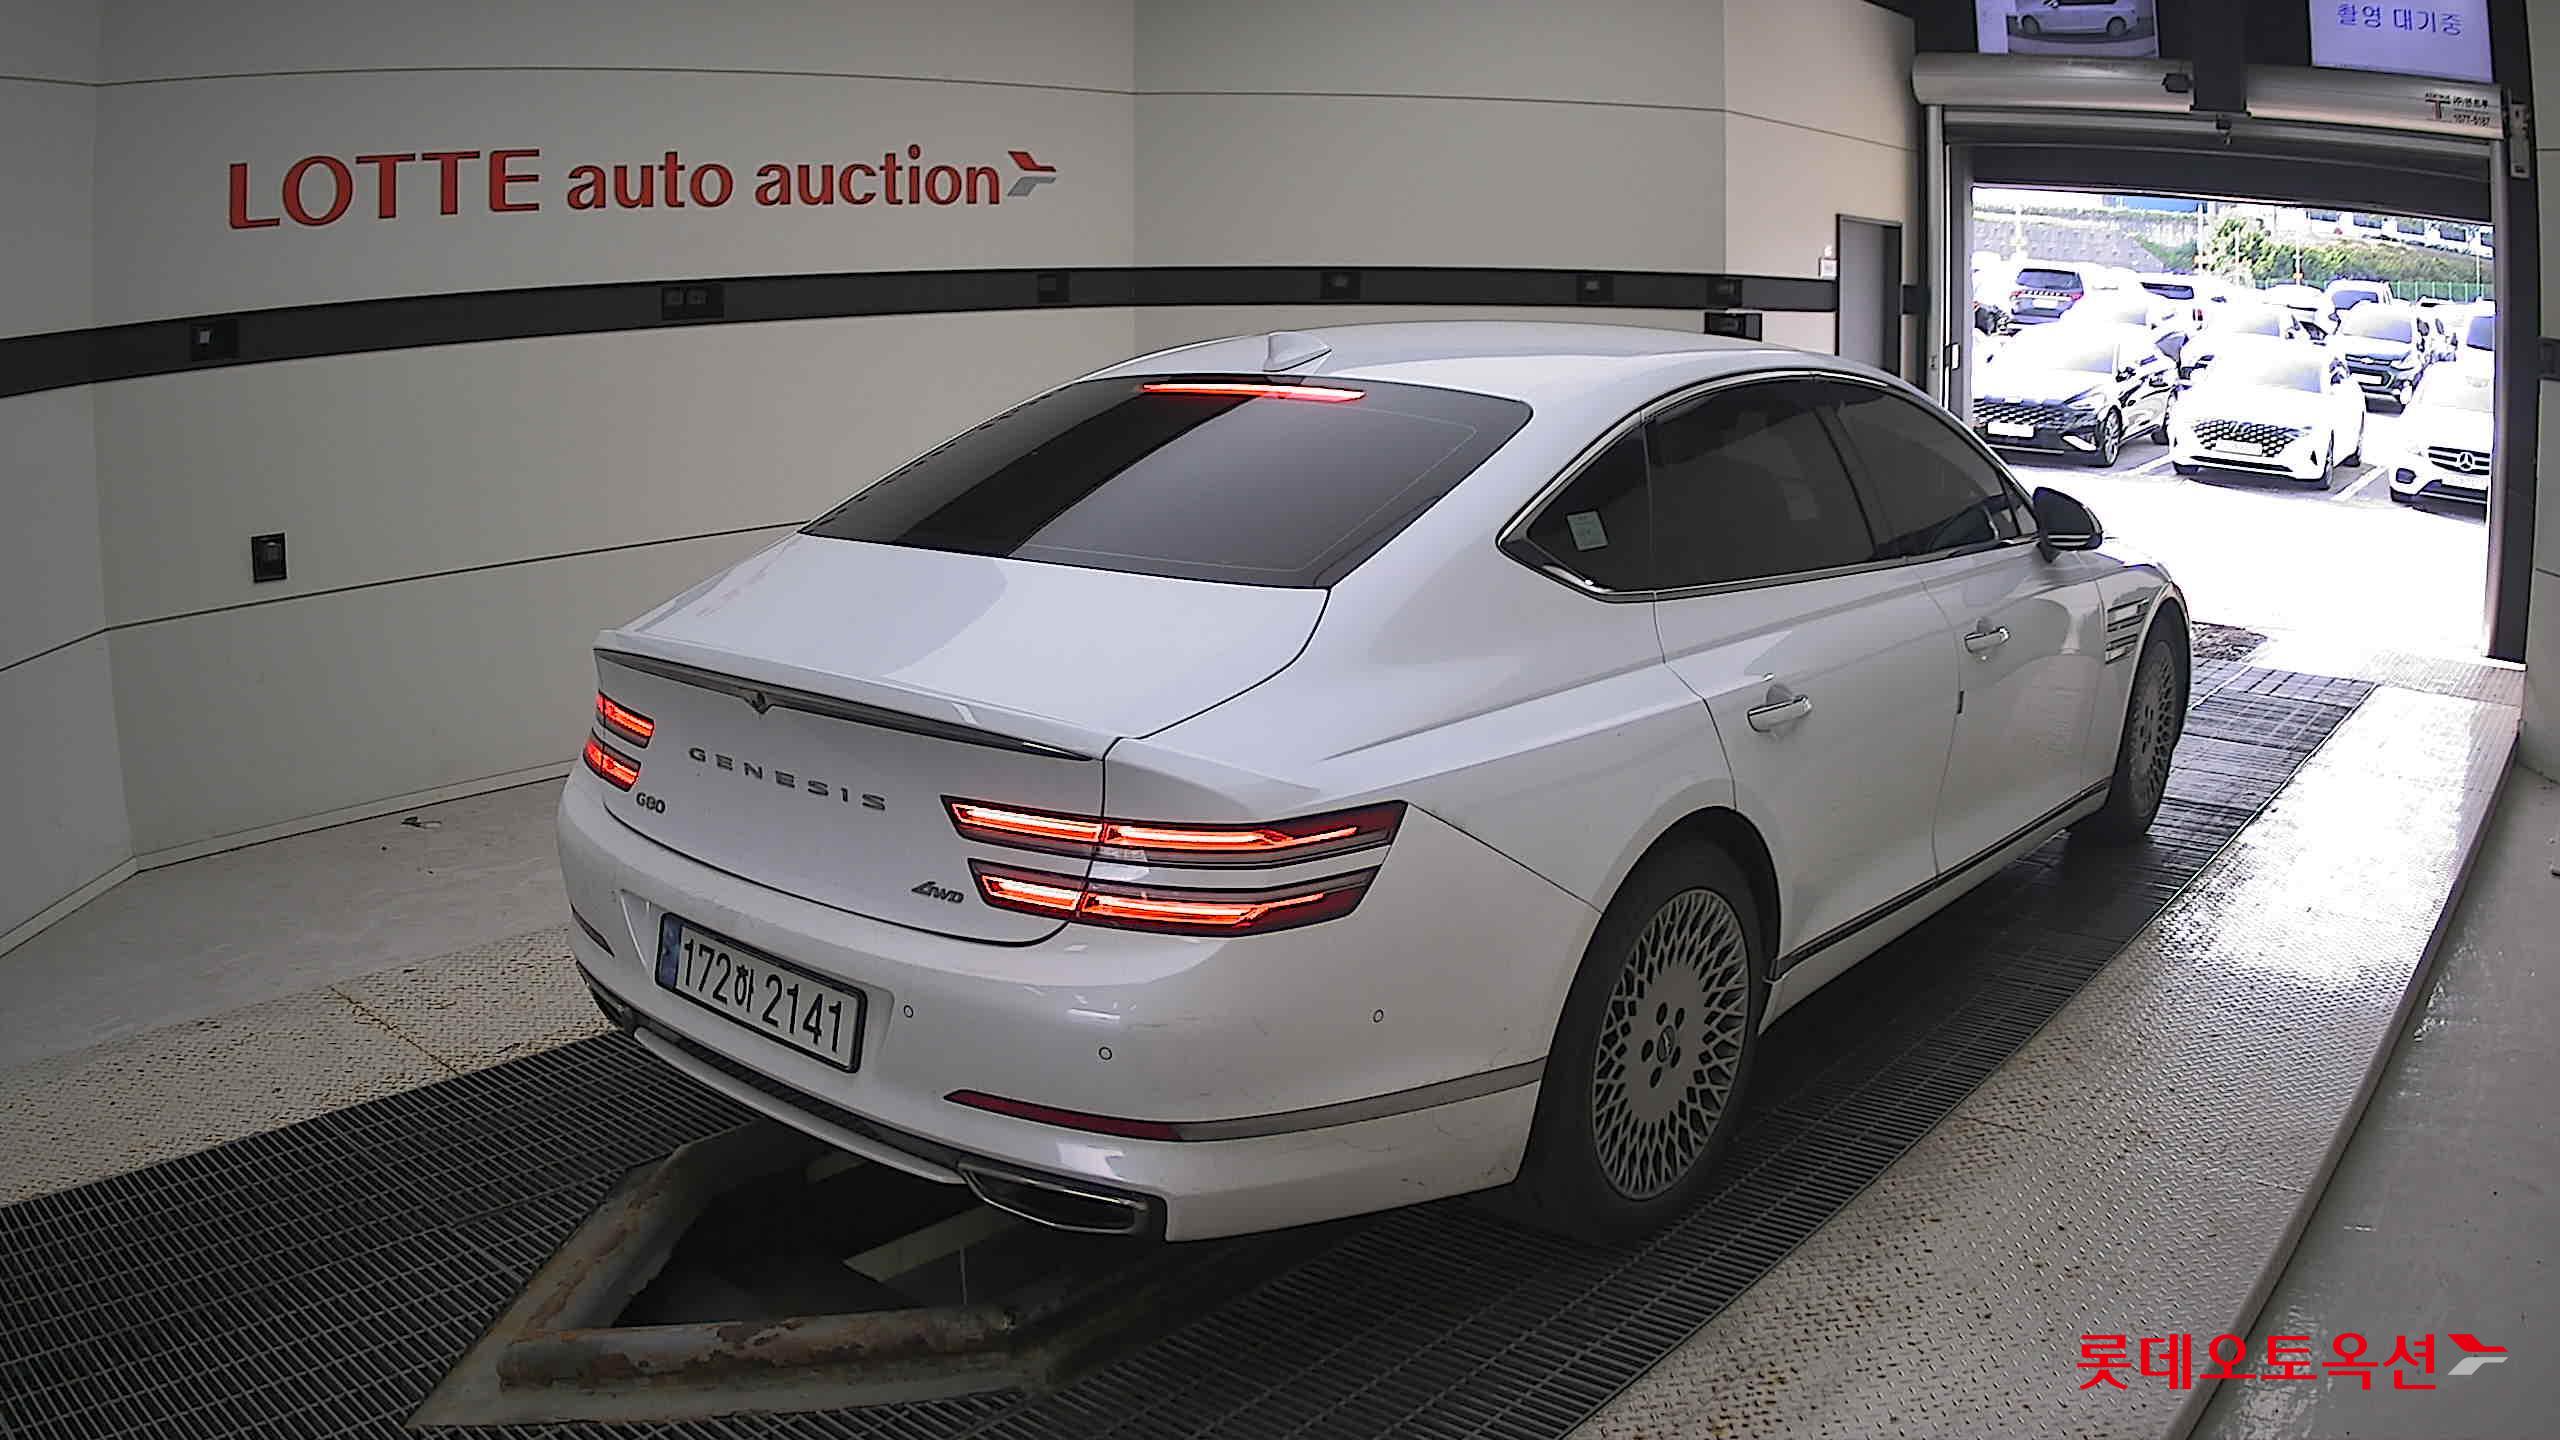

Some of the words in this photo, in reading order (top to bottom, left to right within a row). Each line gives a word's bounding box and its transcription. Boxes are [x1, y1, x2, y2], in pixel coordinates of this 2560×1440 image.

[2337, 3, 2382, 29] 촬영
[2392, 8, 2464, 36] 대기중
[228, 148, 541, 231] LOTTE
[566, 151, 735, 210] auto
[753, 144, 1003, 207] auction
[636, 791, 667, 815] G80
[688, 746, 887, 812] GENESIS
[683, 938, 755, 1014] 172하
[762, 973, 843, 1054] 2141
